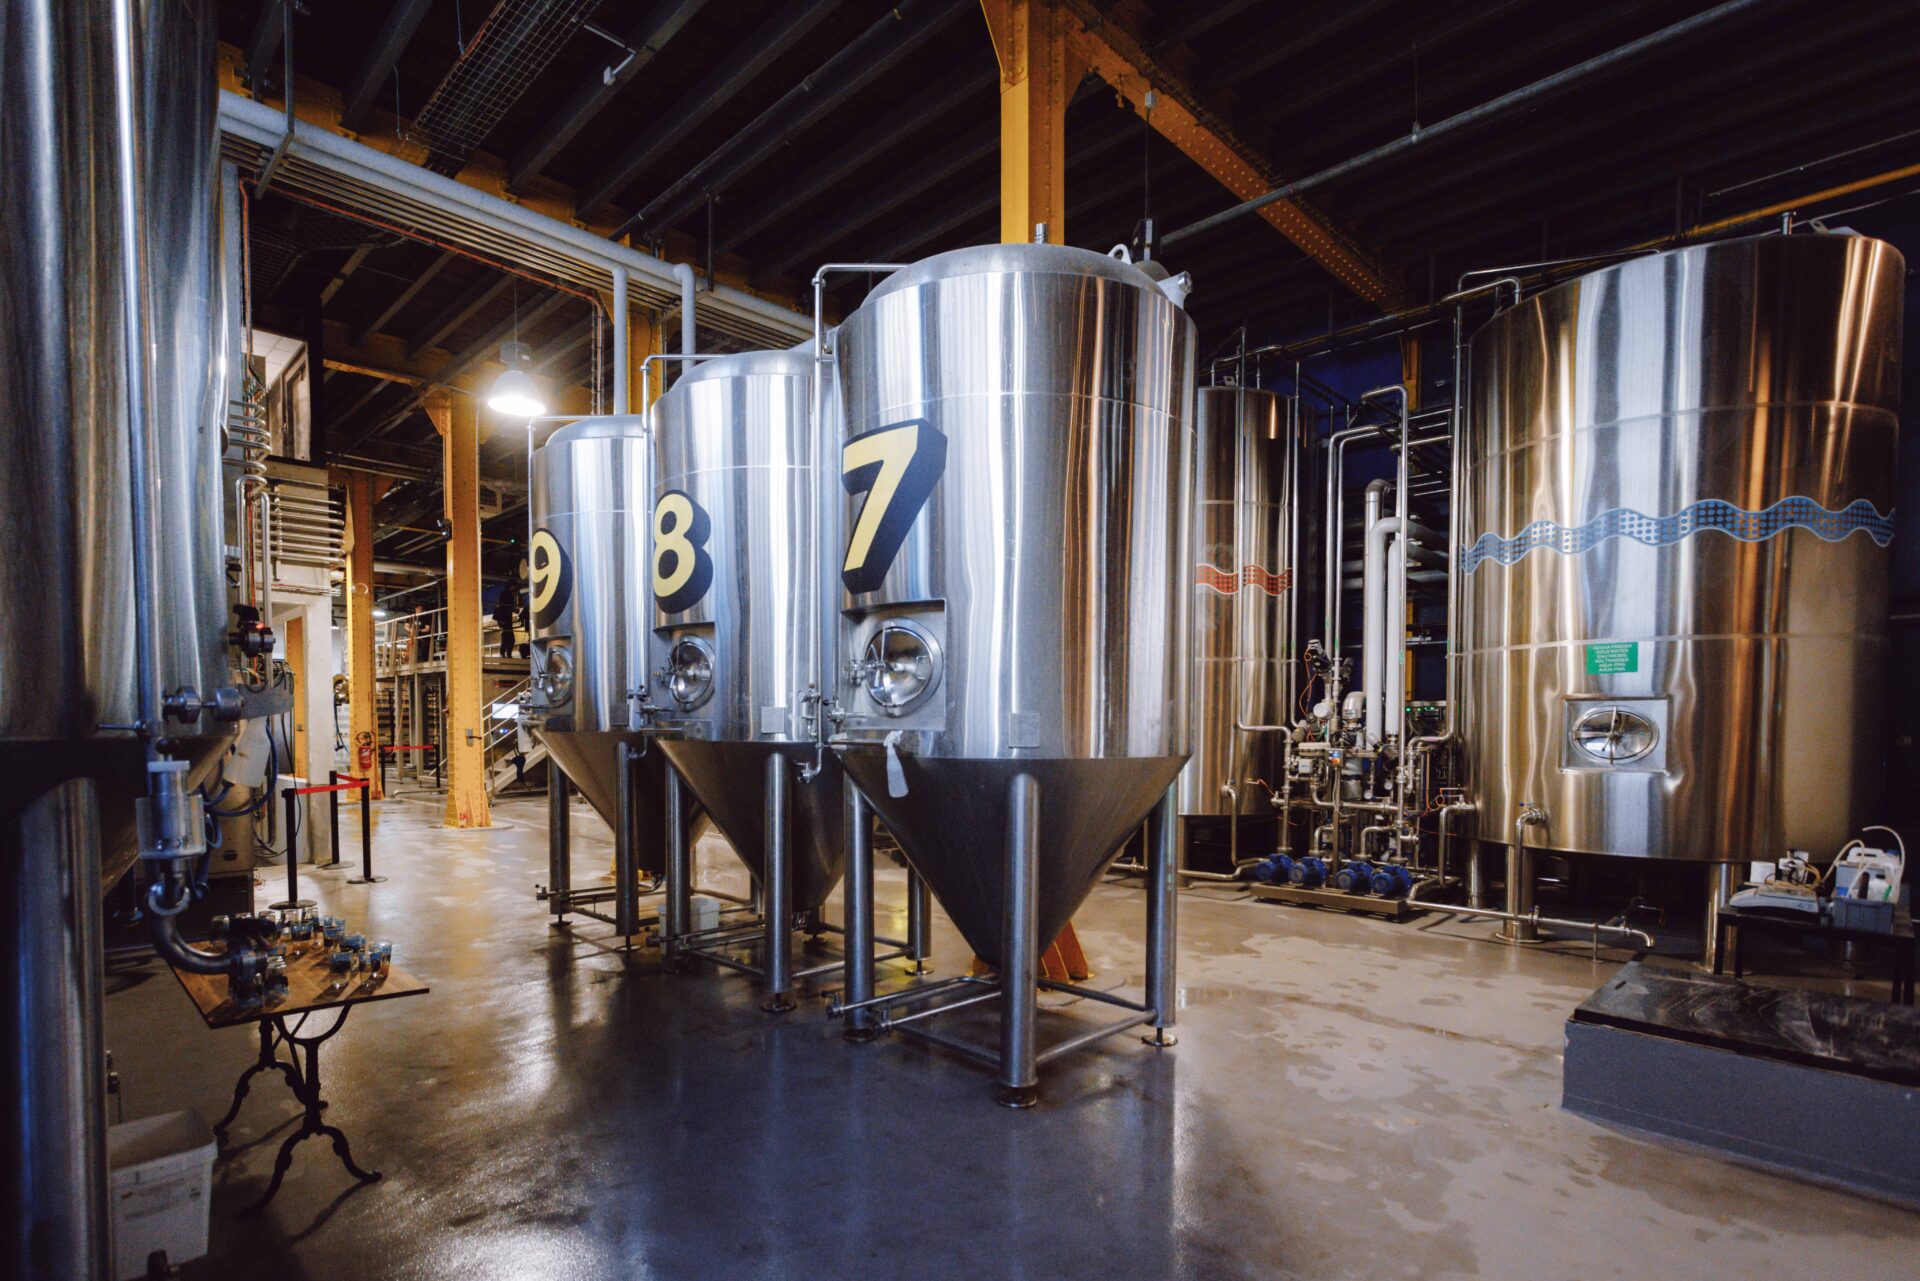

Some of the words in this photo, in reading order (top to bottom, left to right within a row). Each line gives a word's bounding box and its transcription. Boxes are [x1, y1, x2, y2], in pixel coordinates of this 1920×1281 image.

[652, 490, 699, 600] 8
[842, 421, 922, 575] 7
[531, 528, 564, 616] 9
